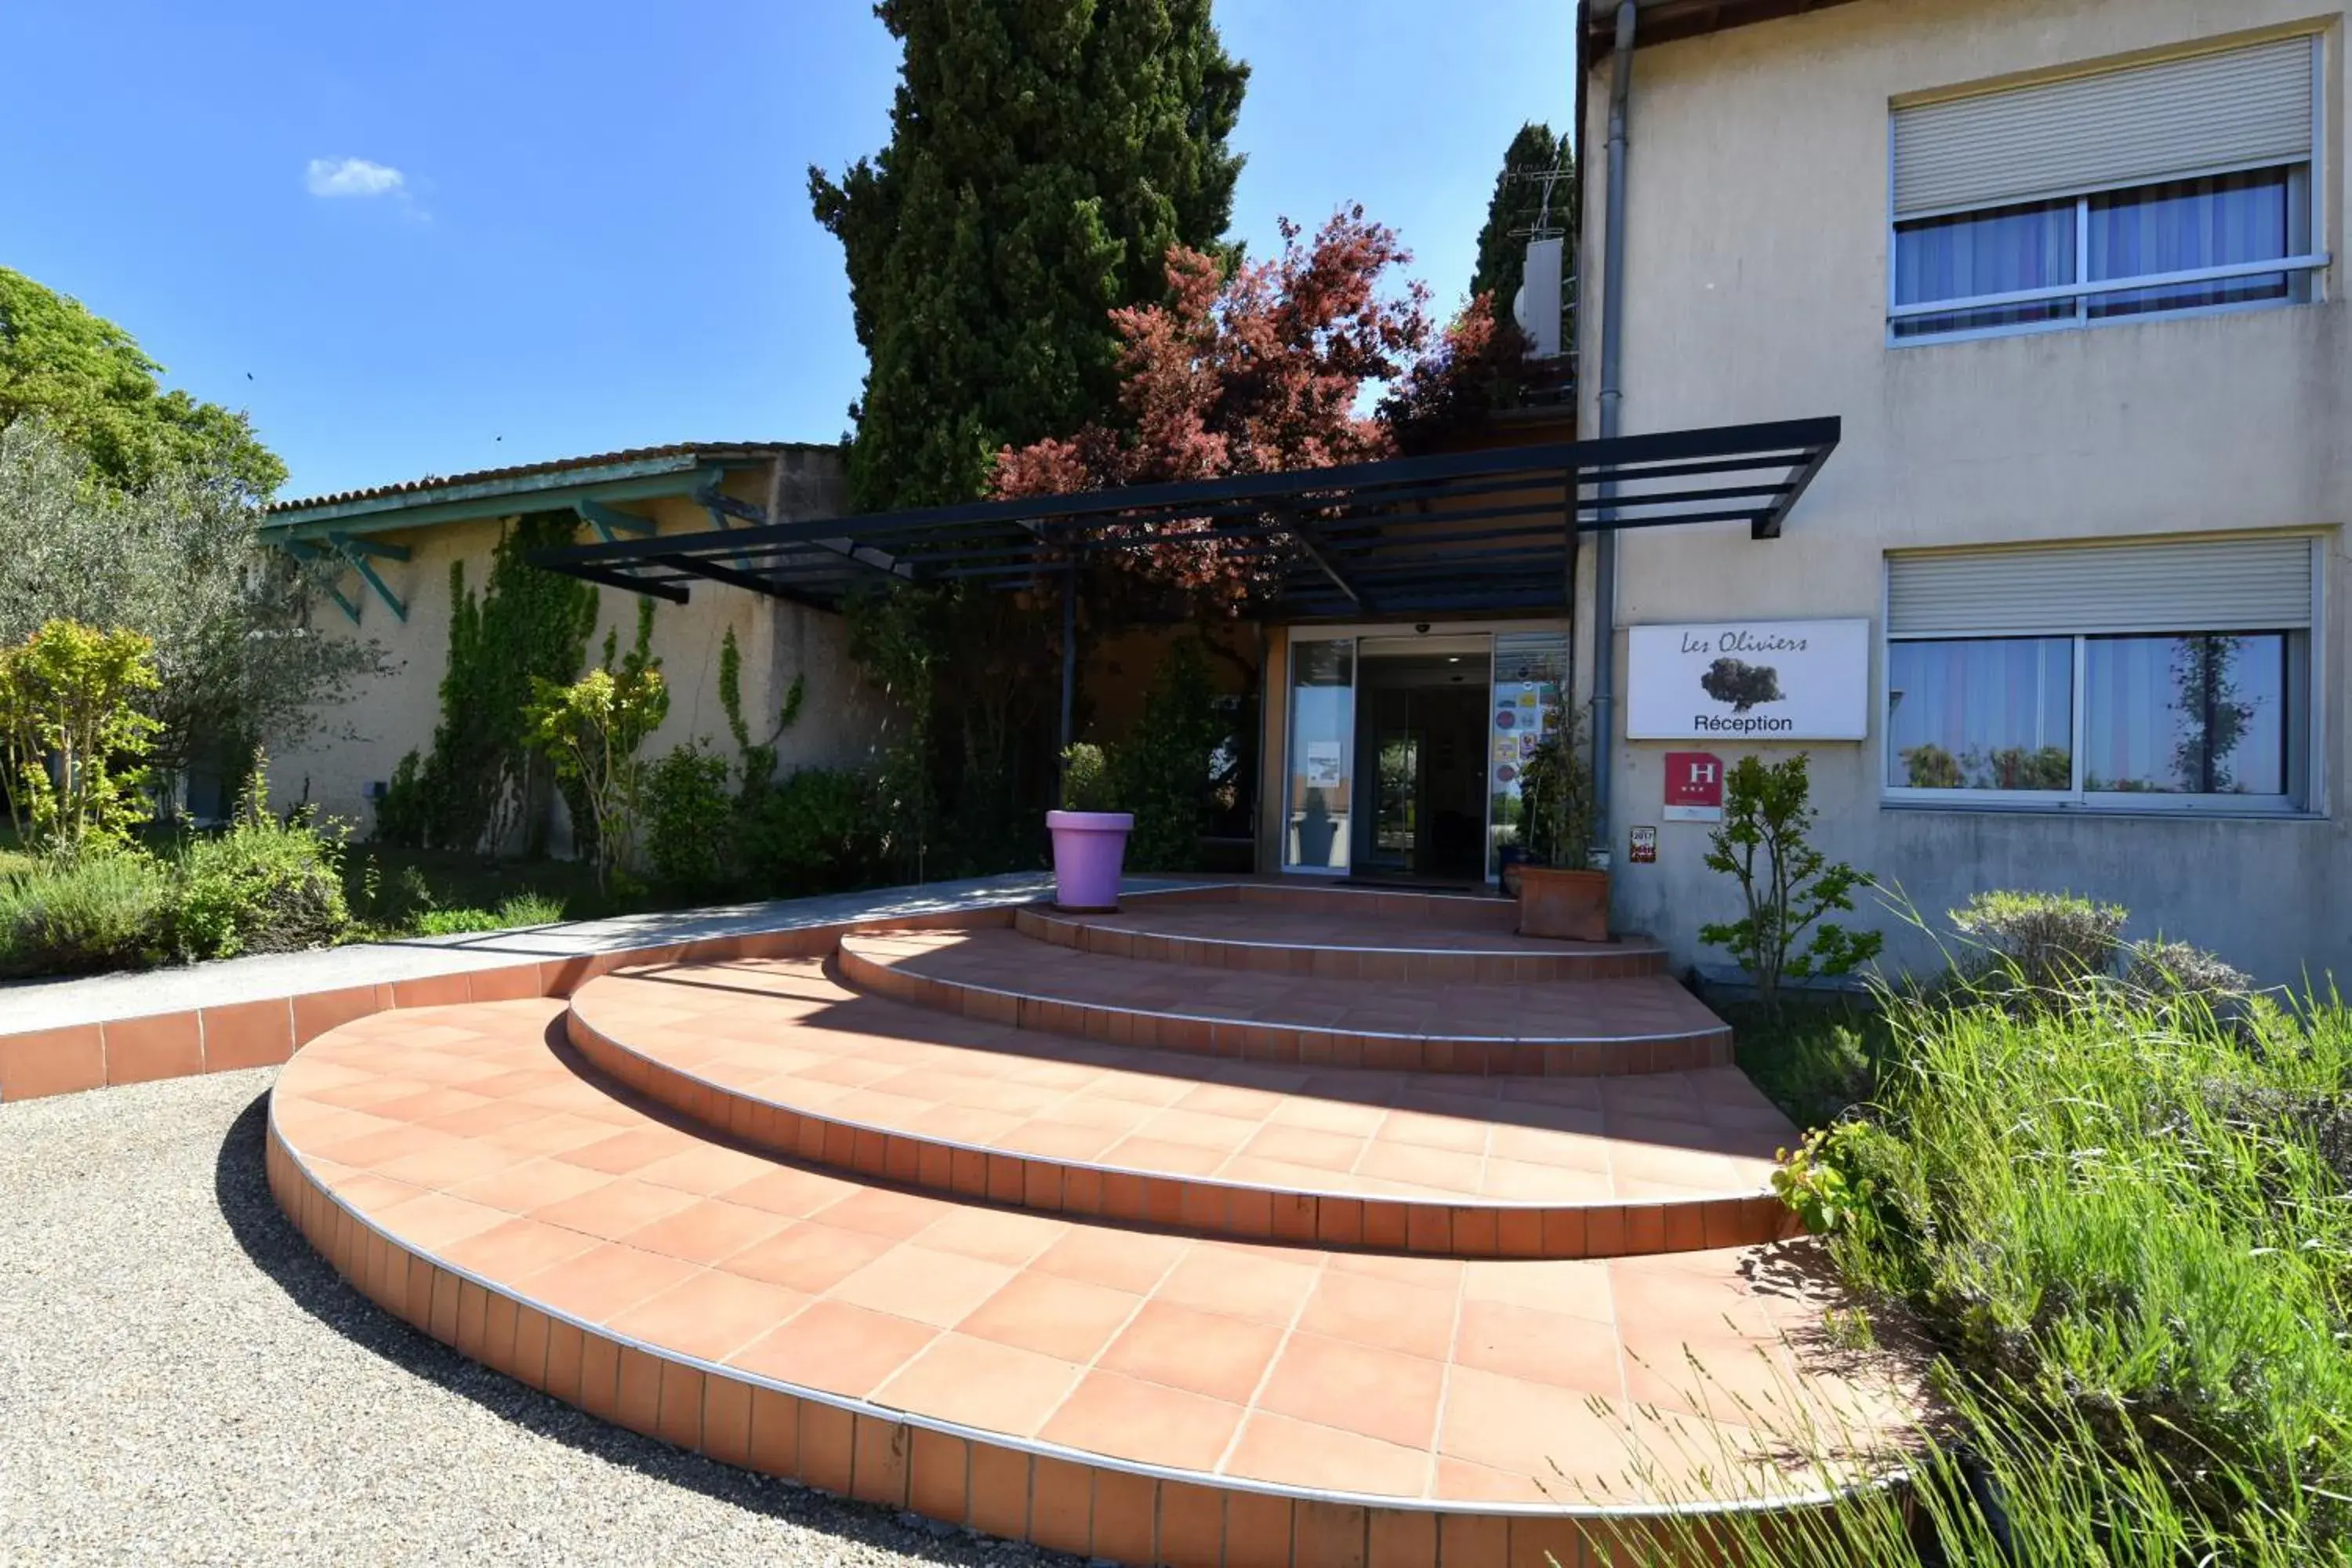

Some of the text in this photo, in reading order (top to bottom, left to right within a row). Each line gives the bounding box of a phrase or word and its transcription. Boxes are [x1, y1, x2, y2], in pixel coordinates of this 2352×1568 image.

[1681, 630, 1807, 653] Les Oliviers
[1694, 714, 1792, 735] Réception
[1690, 763, 1715, 783] H
